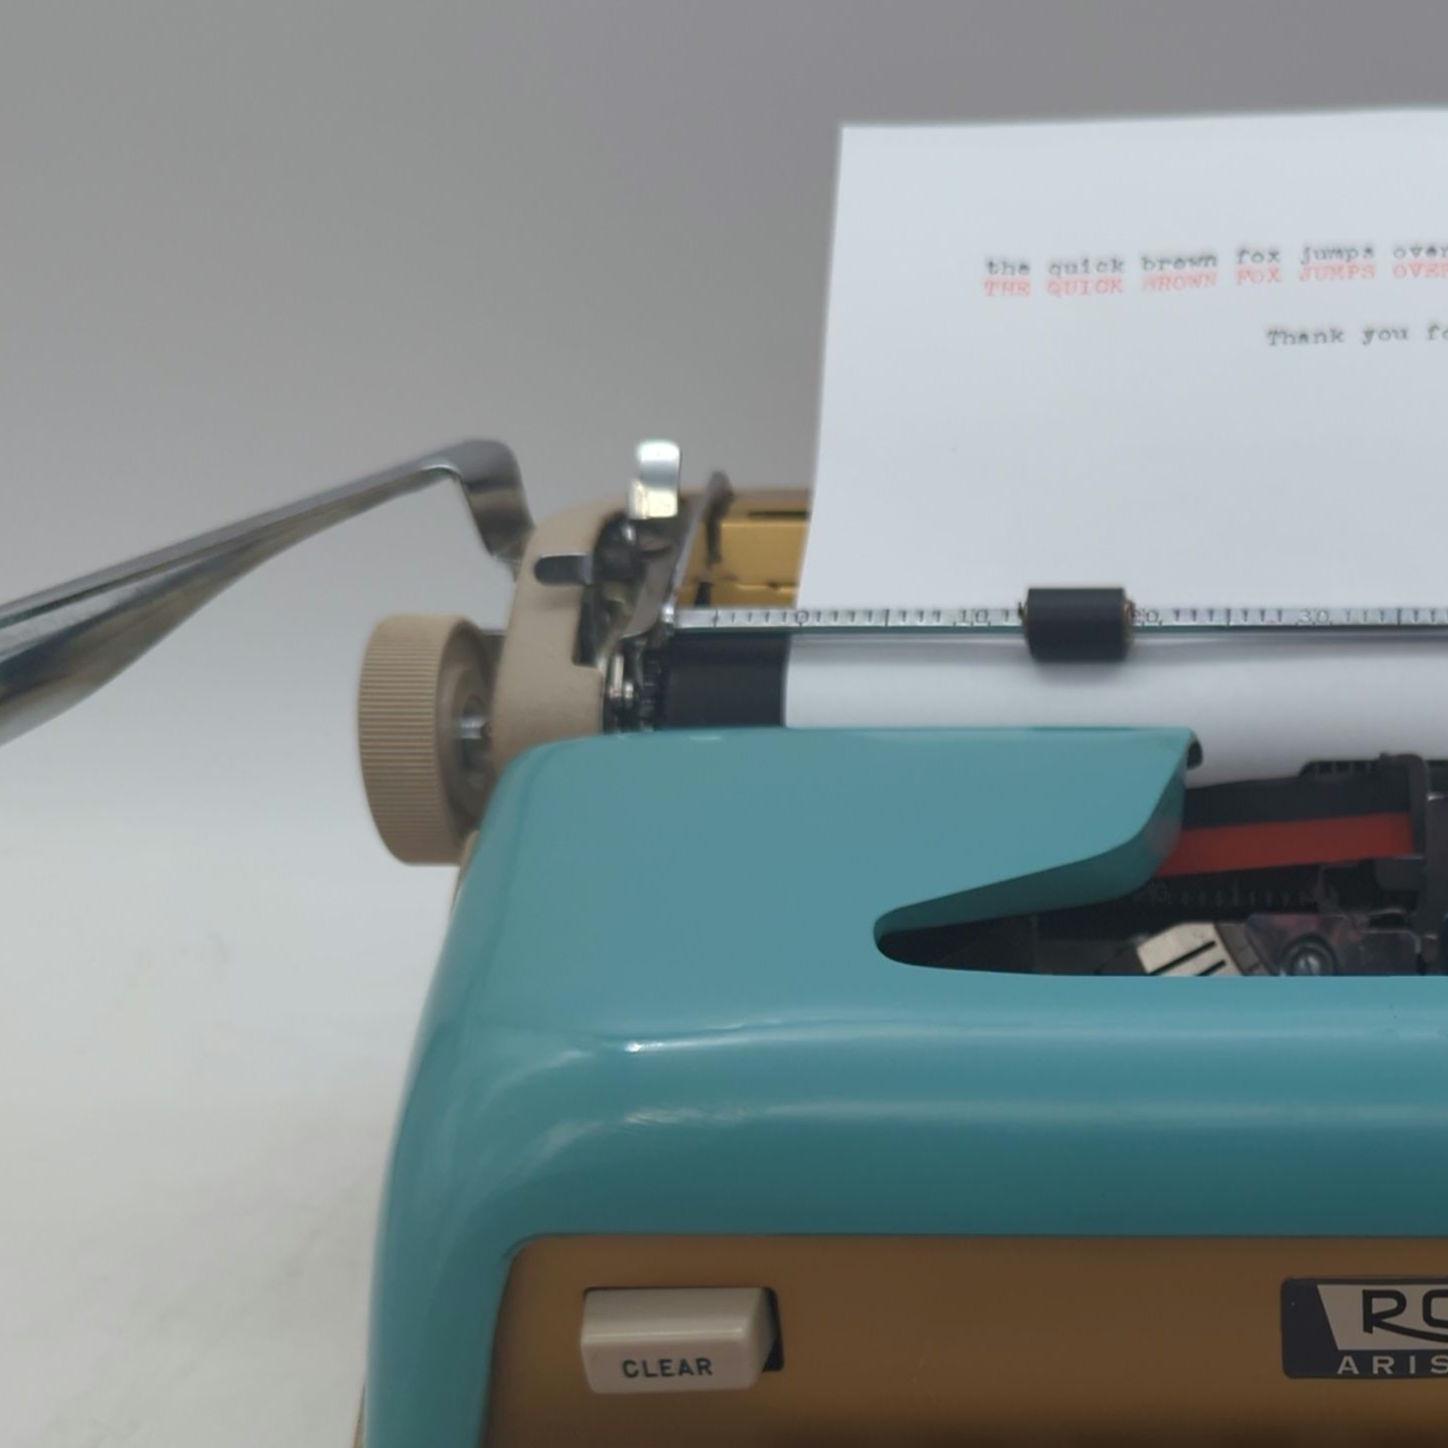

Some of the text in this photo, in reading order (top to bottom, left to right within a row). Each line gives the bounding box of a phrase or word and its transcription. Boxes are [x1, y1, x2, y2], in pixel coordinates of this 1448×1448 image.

[987, 259, 1030, 275] the
[1049, 257, 1125, 277] quick
[1141, 254, 1217, 271] brown
[1237, 247, 1281, 264] fox
[1300, 246, 1375, 265] jumps
[1047, 278, 1124, 297] QUICK
[1237, 266, 1281, 285] FOX
[1268, 327, 1345, 346] Thank
[1362, 326, 1408, 345] you
[1300, 608, 1330, 623] 30
[622, 1358, 712, 1378] CLEAR
